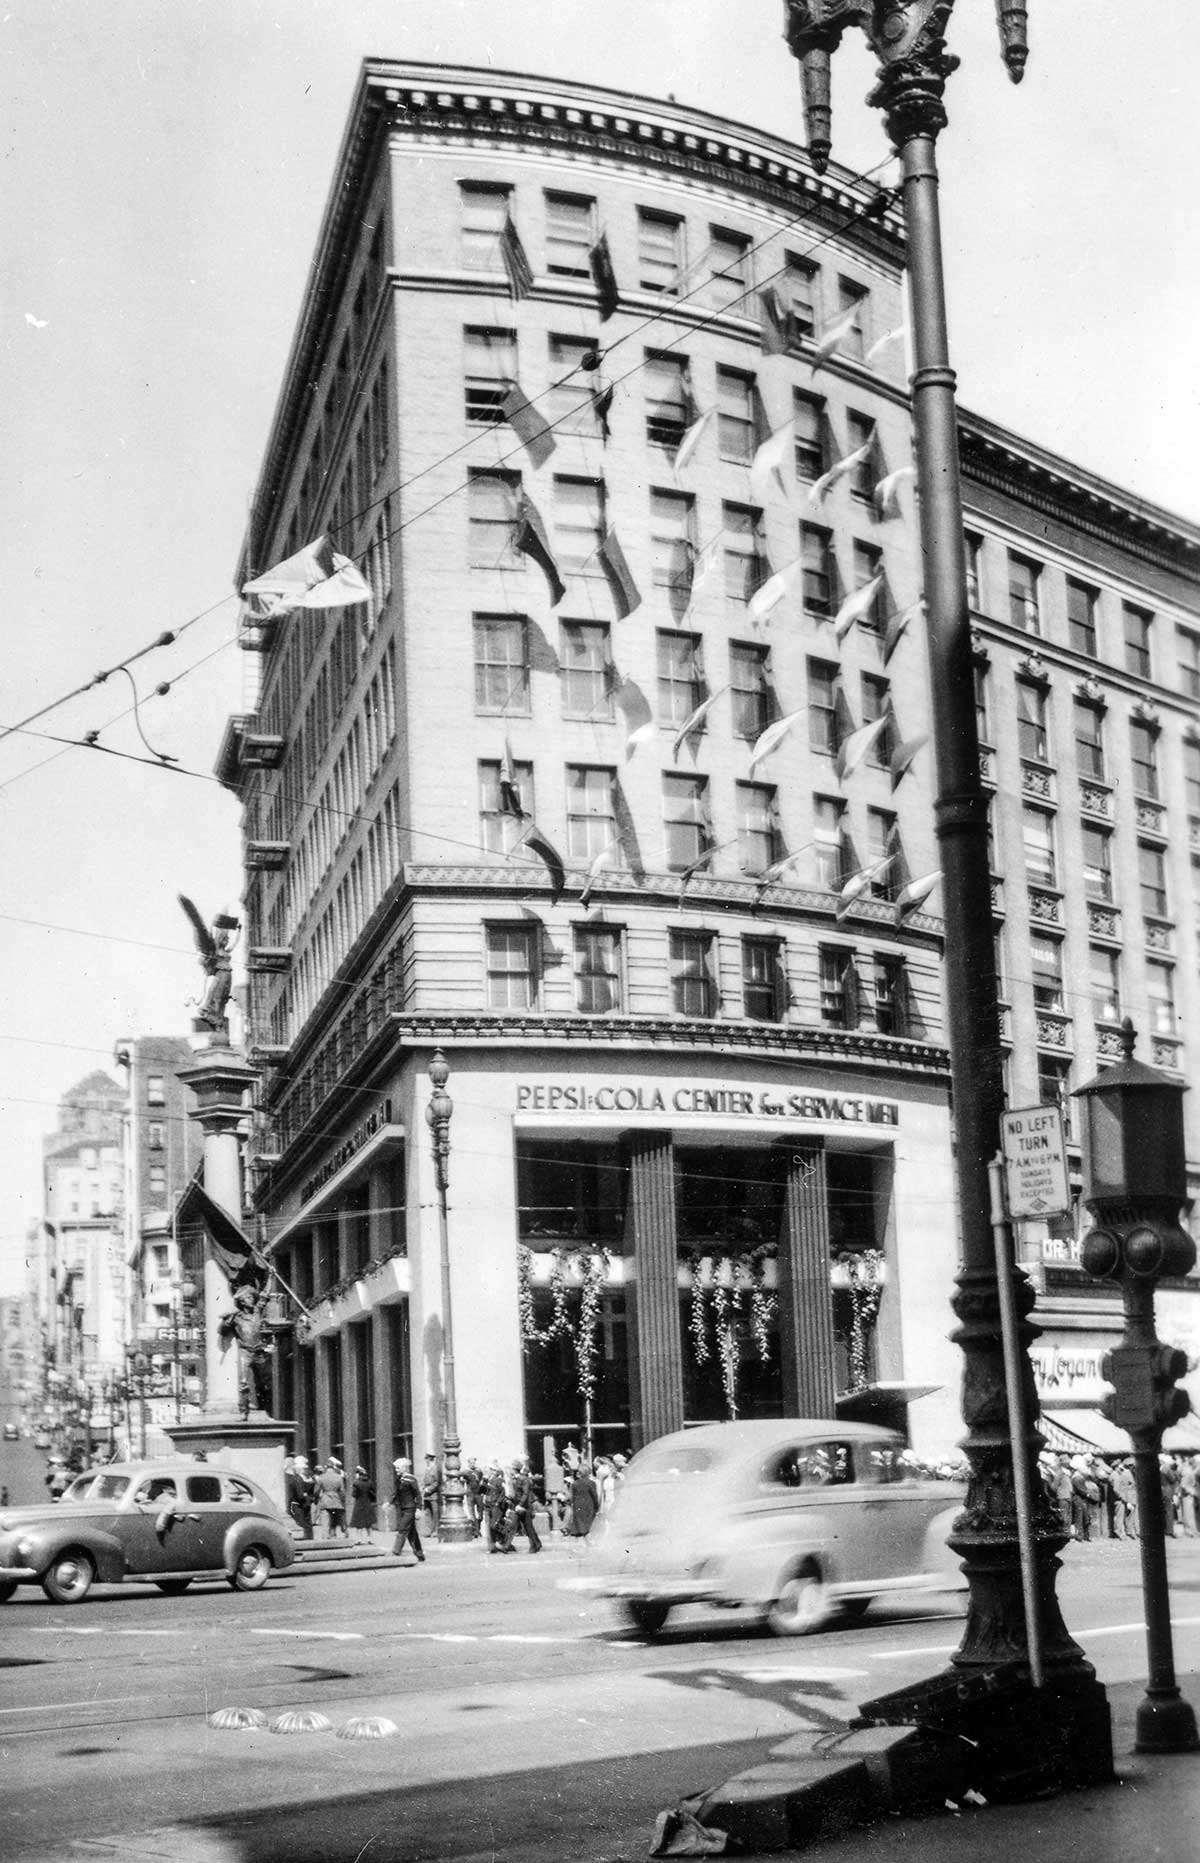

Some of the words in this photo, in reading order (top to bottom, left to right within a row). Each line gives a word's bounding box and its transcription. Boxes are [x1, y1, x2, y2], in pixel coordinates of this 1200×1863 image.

[672, 1088, 754, 1116] CENTER
[787, 1094, 864, 1122] SERVICE
[1008, 1120, 1023, 1134] NO
[1028, 1115, 1056, 1132] LEFT
[1019, 1135, 1049, 1151] TURN
